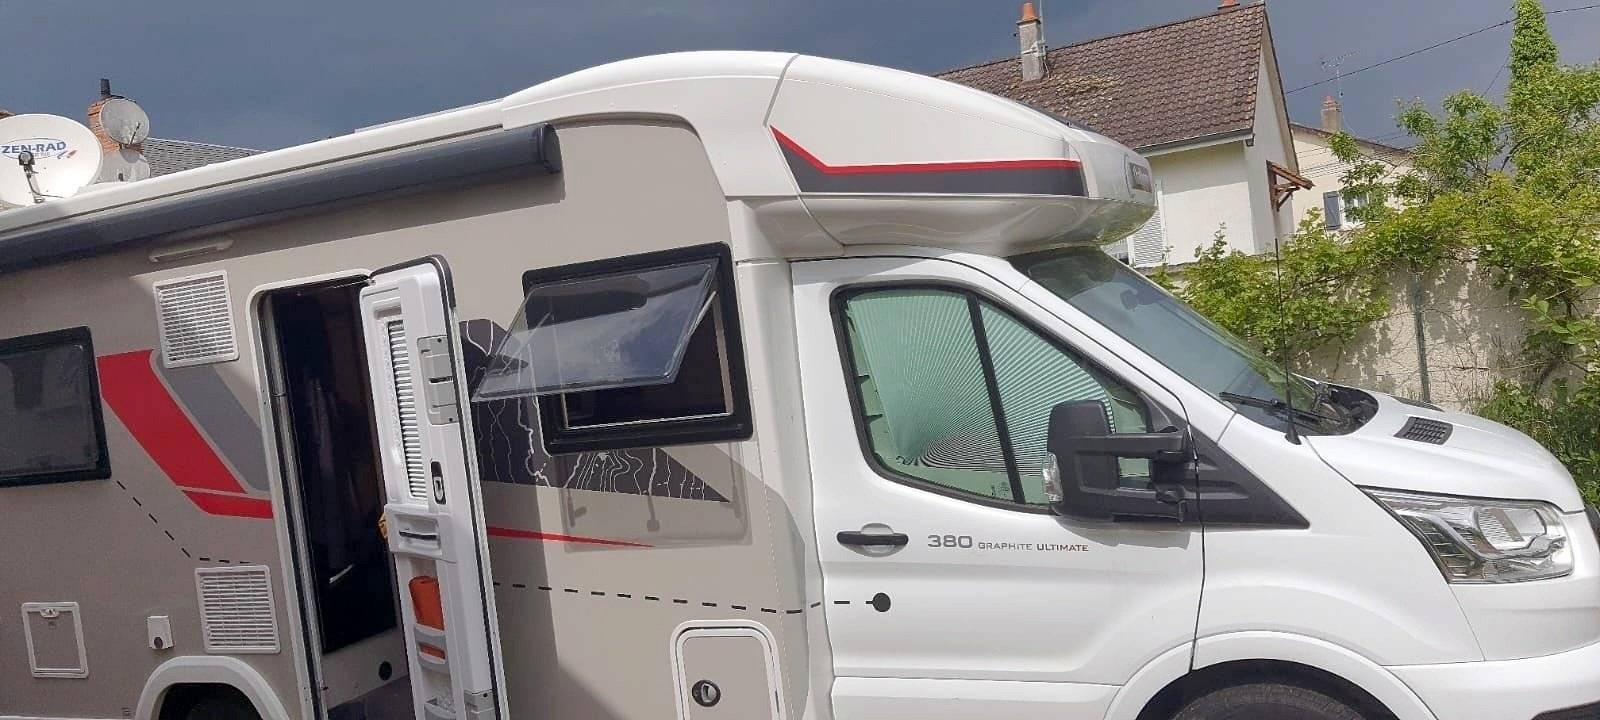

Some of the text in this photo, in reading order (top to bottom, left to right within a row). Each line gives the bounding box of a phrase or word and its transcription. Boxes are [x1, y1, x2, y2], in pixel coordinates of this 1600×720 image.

[1, 141, 67, 154] ZEN-RAD
[927, 534, 1089, 552] 380 GRAPHITE ULTIMATE
